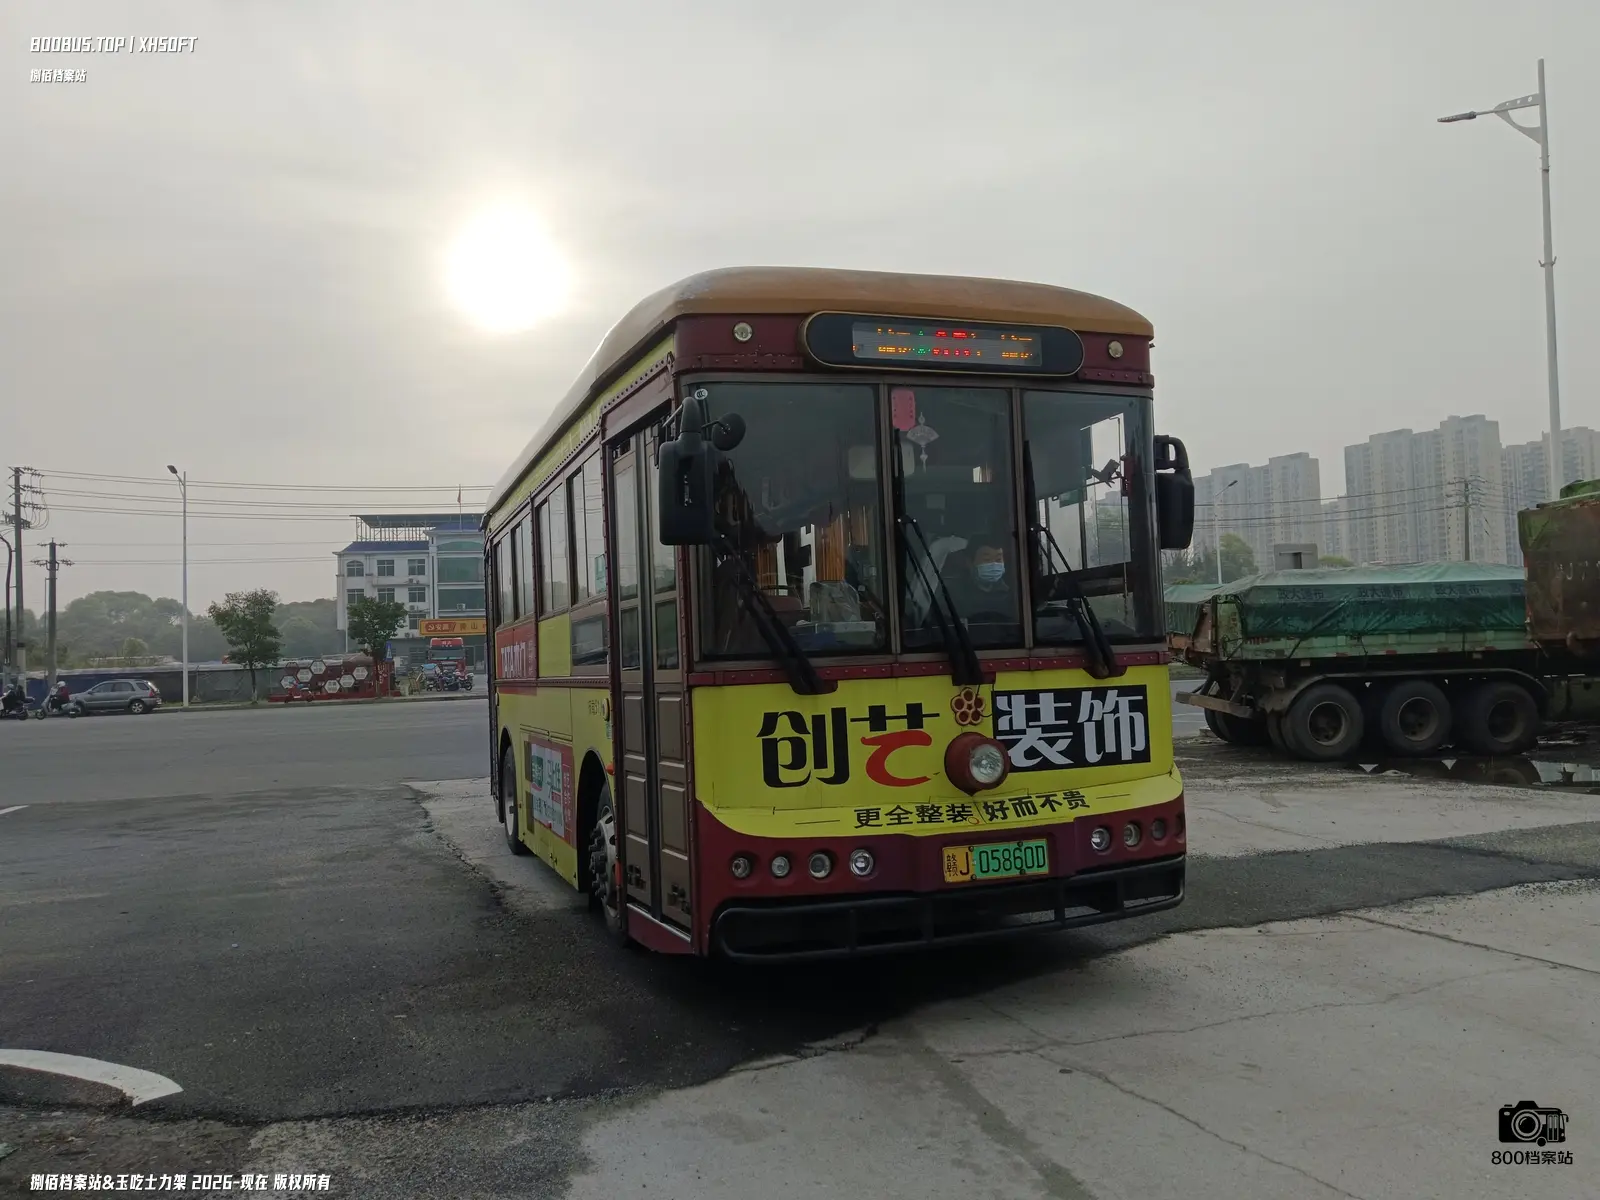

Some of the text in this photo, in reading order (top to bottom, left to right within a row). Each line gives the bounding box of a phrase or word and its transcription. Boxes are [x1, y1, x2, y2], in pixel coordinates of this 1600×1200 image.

[756, 689, 1148, 788] 创艺 装饰
[853, 790, 1090, 829] 更全整装 好而不贵
[979, 845, 1046, 874] 05860D
